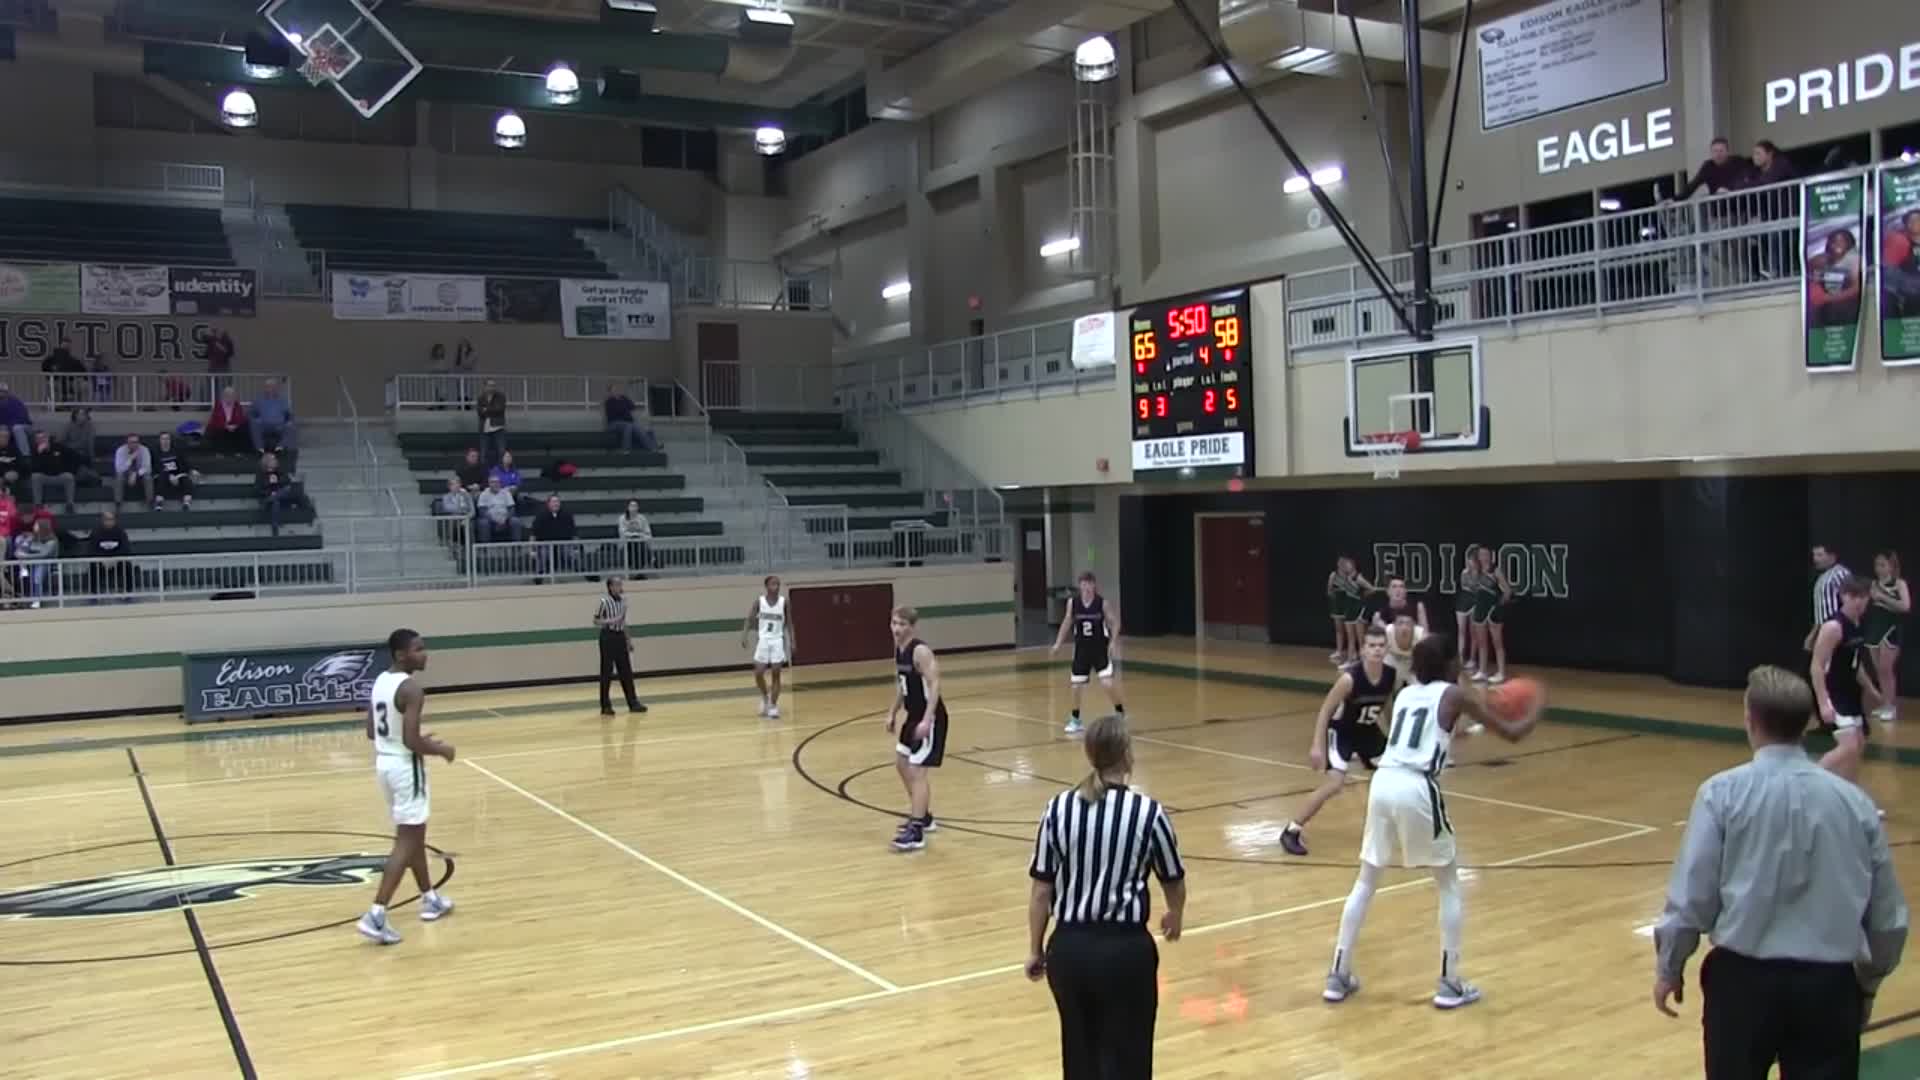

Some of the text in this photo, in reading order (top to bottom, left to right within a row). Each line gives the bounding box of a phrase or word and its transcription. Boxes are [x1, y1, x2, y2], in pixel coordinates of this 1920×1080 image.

[1764, 42, 1920, 123] PRIDE
[1536, 108, 1674, 175] EAGLE
[1168, 305, 1206, 338] 5:50
[1214, 317, 1239, 348] 58
[1135, 332, 1156, 361] 65
[1199, 346, 1209, 364] 4
[1139, 388, 1237, 419] 9 3 2 5
[1144, 437, 1230, 459] EAGLE PRIDE
[1373, 543, 1568, 597] EDION
[1082, 621, 1093, 637] 2
[216, 658, 295, 686] Edison
[376, 701, 389, 737] 3
[1357, 705, 1381, 725] 15
[1390, 706, 1429, 749] 11
